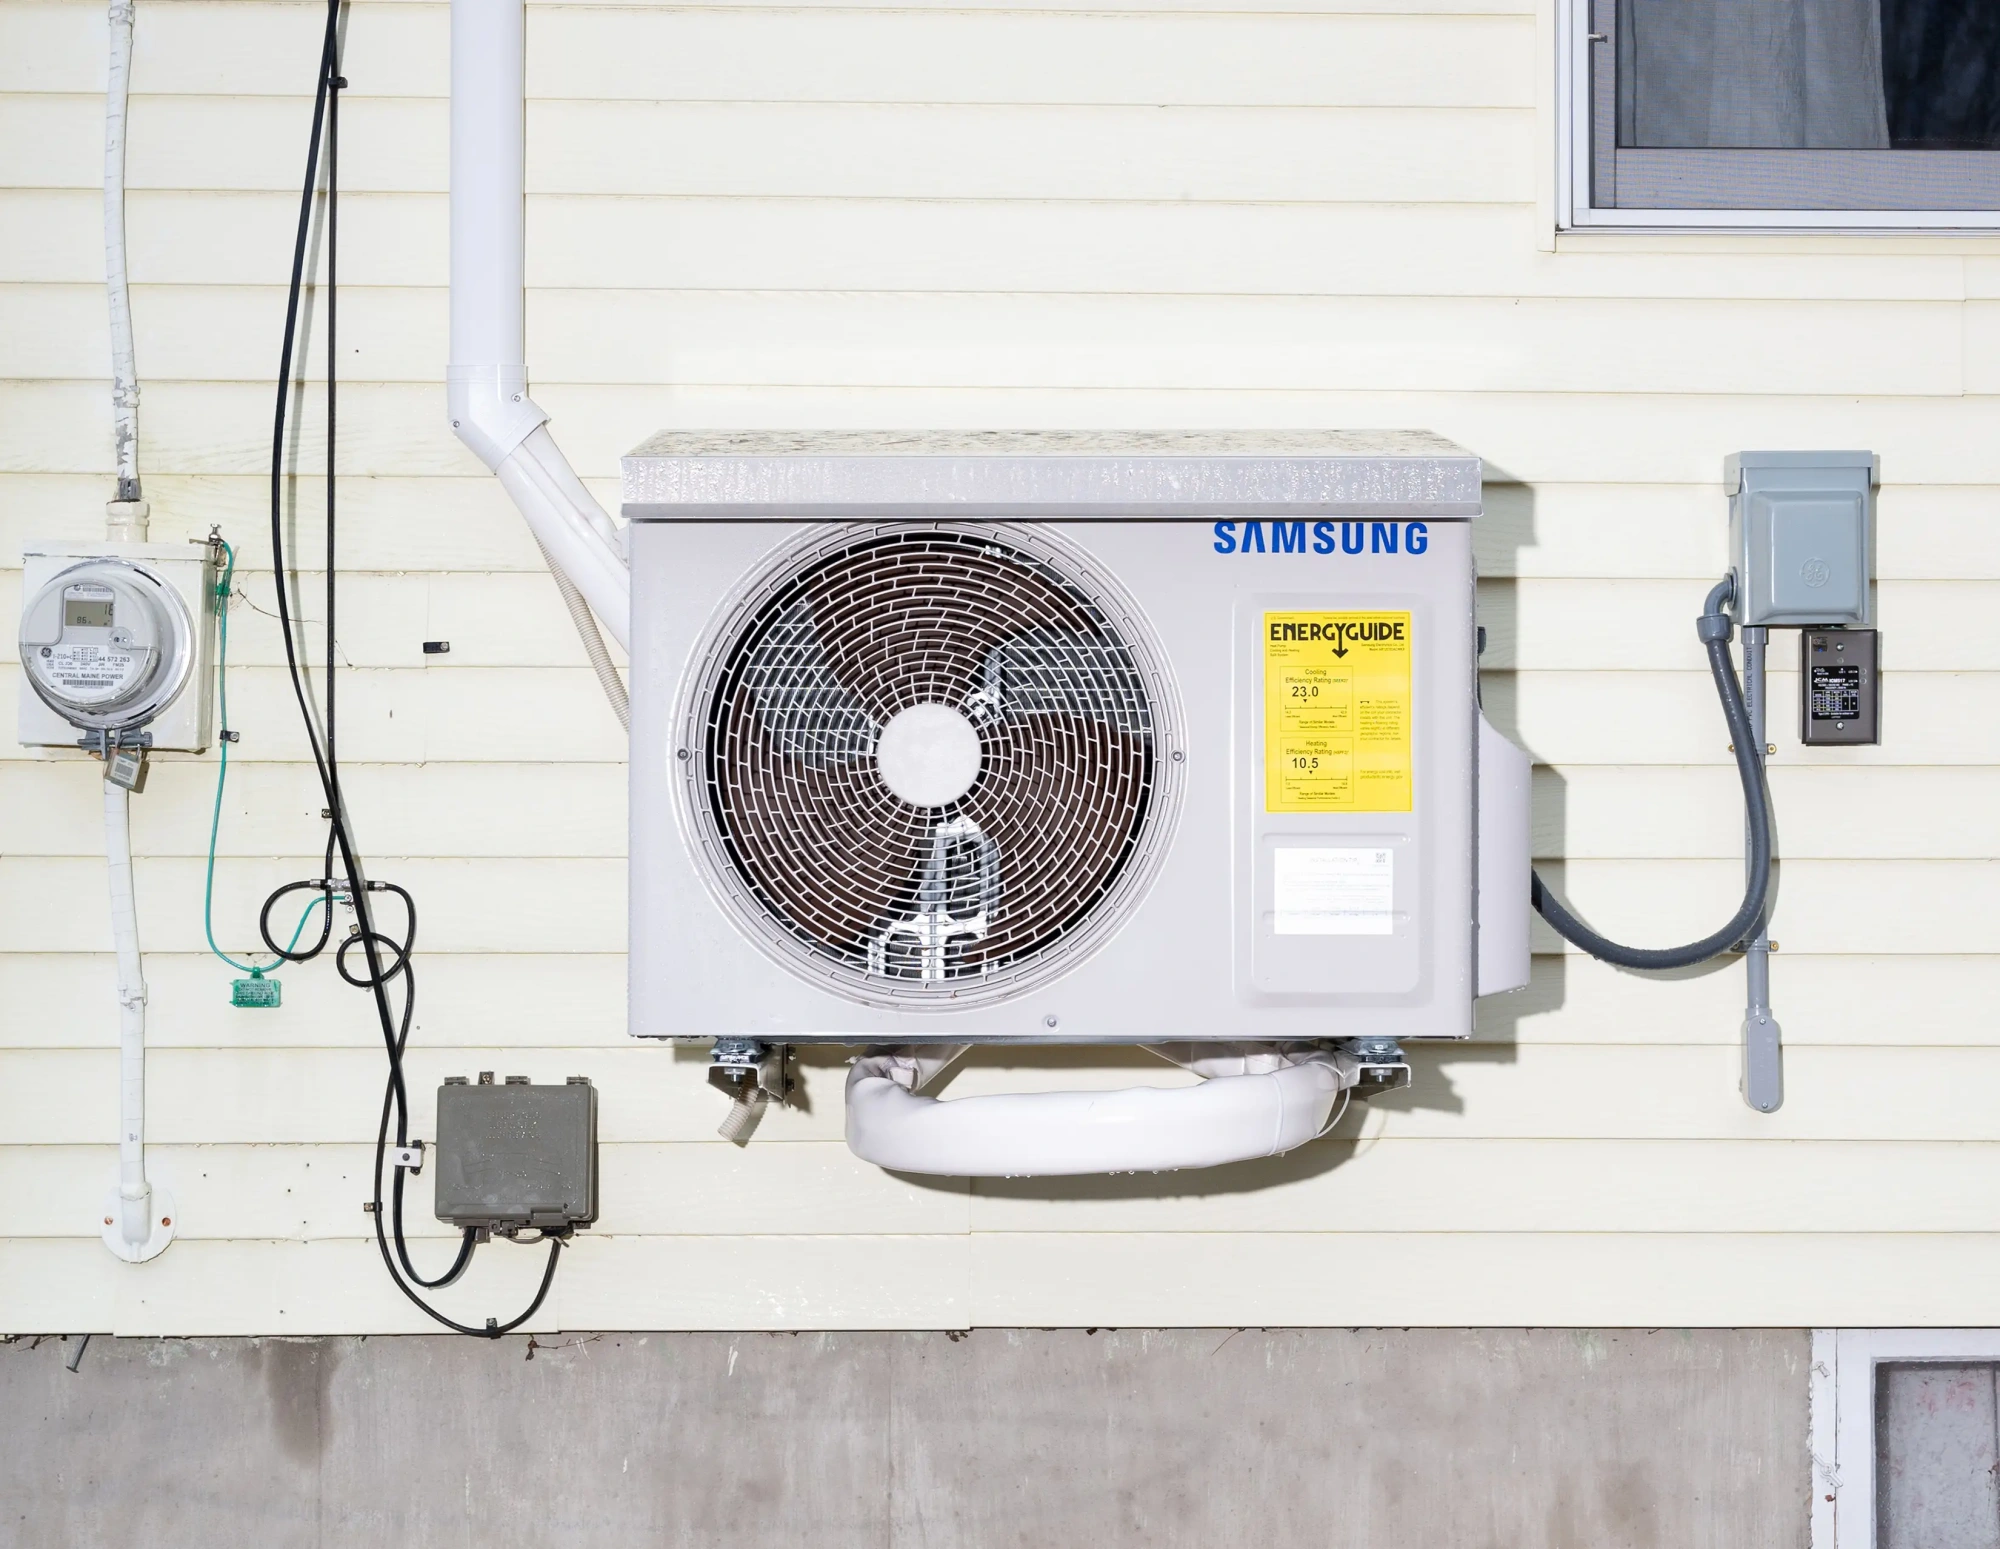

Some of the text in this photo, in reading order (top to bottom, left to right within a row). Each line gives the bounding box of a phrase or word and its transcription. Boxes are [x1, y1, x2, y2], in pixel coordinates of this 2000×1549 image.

[1214, 521, 1428, 555] SAMSUNG
[1270, 622, 1405, 641] ENERGYGUIDE
[1292, 686, 1318, 697] 23.0
[1292, 758, 1319, 768] 10.5
